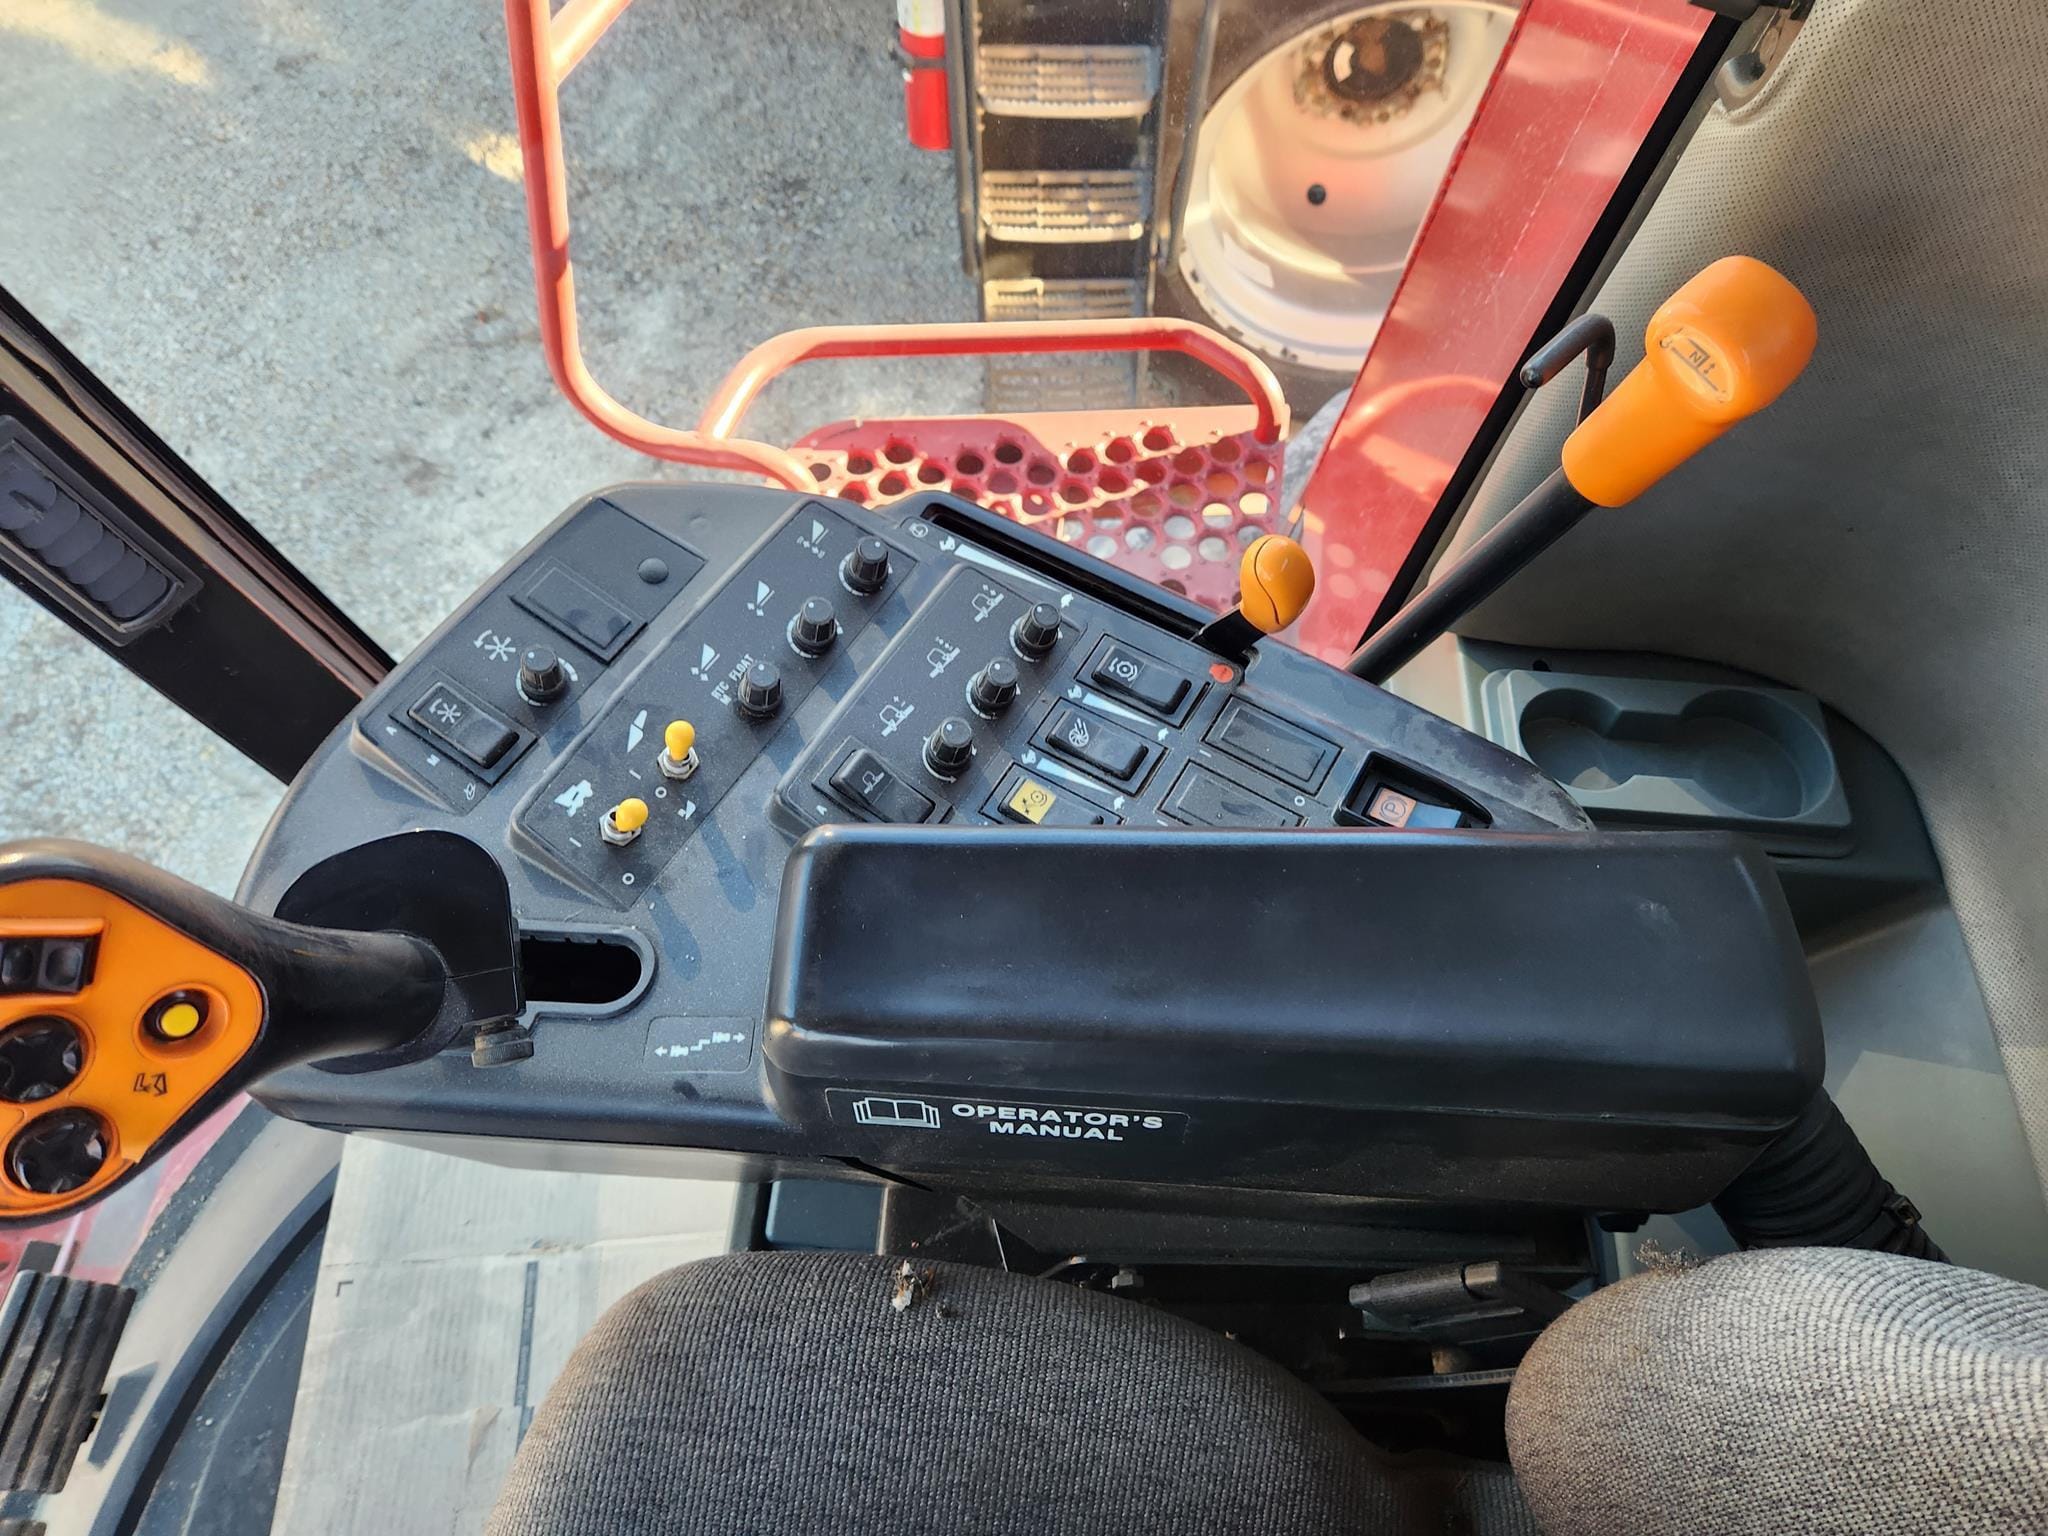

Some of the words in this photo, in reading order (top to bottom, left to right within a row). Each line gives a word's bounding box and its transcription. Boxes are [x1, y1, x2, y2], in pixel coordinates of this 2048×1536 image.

[728, 653, 754, 682] FLOAT
[951, 1103, 1164, 1129] OPERATOR'S
[989, 1121, 1124, 1142] MANUAL
